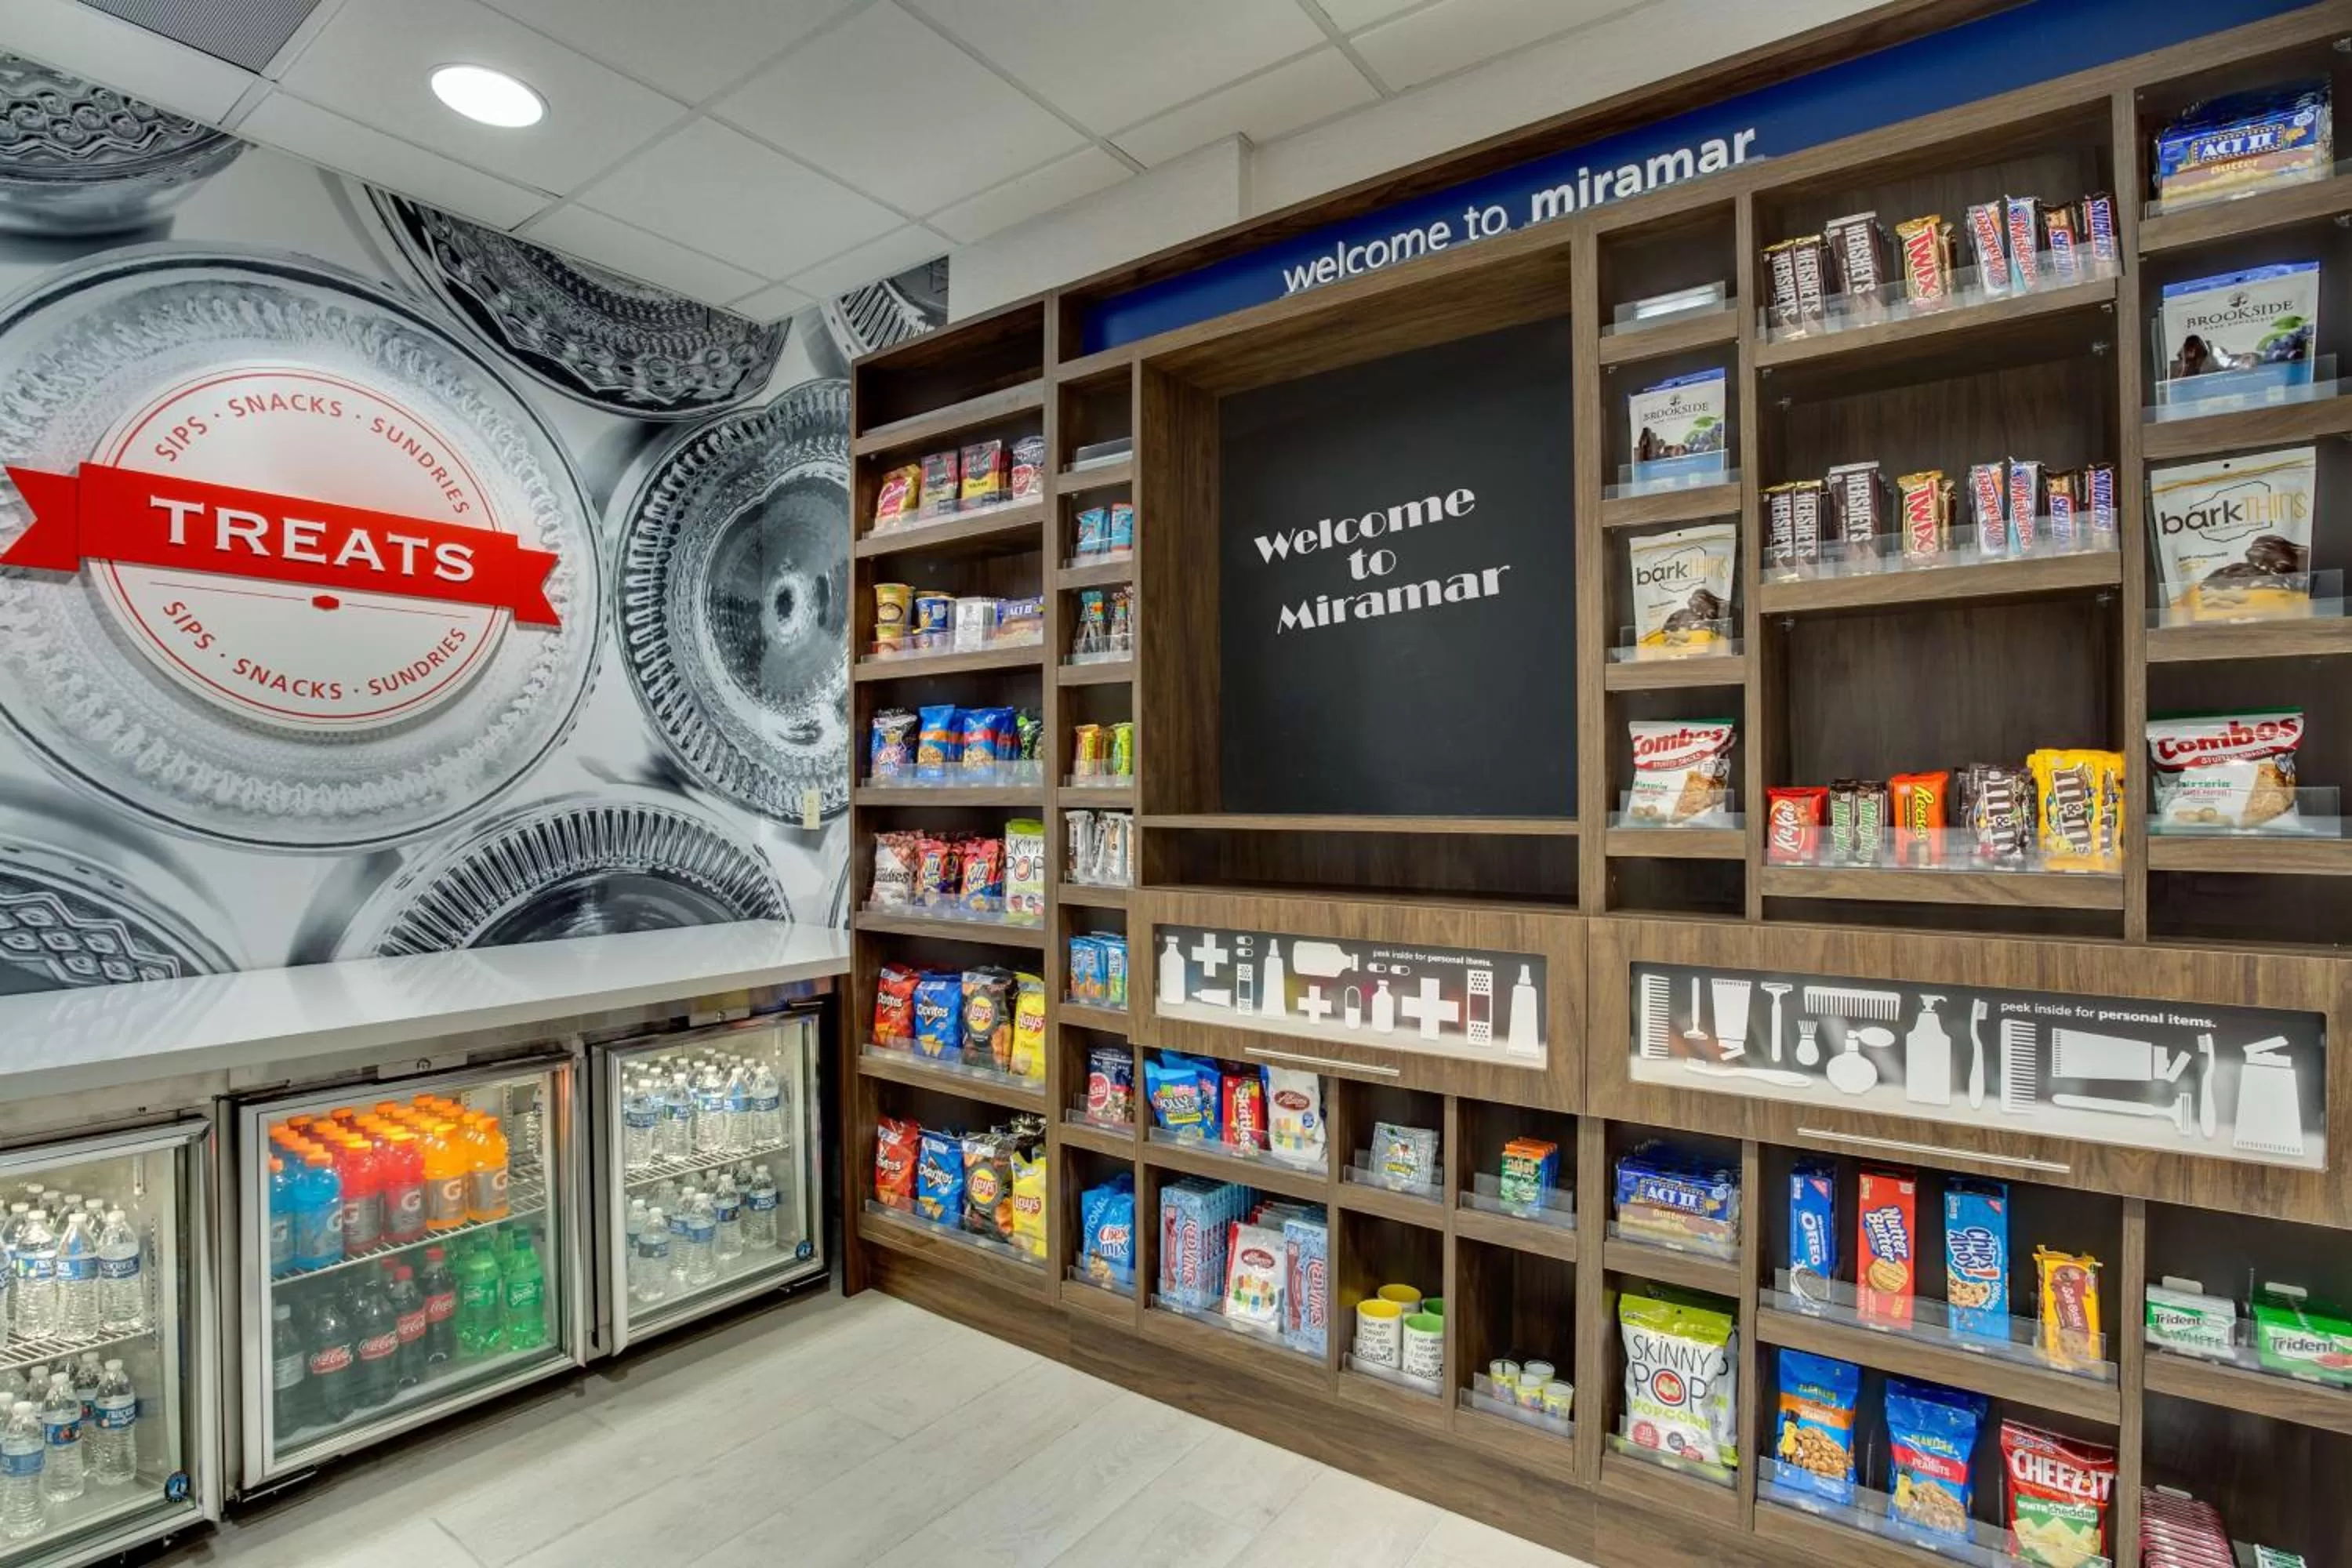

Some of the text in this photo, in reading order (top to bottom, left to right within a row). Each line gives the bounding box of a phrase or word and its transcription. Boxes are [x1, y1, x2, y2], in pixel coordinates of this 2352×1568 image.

[2201, 132, 2274, 158] ACT II
[1283, 127, 1757, 294] welcome to miramar
[2091, 200, 2113, 259] SNICKERS
[1845, 223, 1877, 296] HERSHEY'S
[1907, 225, 1938, 298] TWIX
[2186, 300, 2294, 329] BROOKSIDE
[1642, 401, 1709, 422] BROOKSIDE
[154, 393, 471, 516] SIPS SNACKS SUNDRIES
[1254, 488, 1476, 564] Welcome
[1846, 473, 1873, 543] HERSHEY'S
[1907, 481, 1936, 553] TWIX
[2093, 470, 2112, 531] SNICKERS
[149, 495, 477, 583] TREATS
[1347, 548, 1397, 581] to
[1276, 564, 1511, 636] Miramar
[162, 599, 466, 701] SIPS SNACKS SUNDRIES
[1633, 728, 1724, 759] Combos
[2158, 717, 2299, 760] Combos
[1008, 838, 1044, 855] SKINN
[1427, 955, 1464, 964] personal
[916, 1003, 949, 1018] Doritos
[2000, 1003, 2031, 1014] peek
[2034, 1003, 2072, 1017] inside
[2074, 1006, 2095, 1018] for
[2098, 1010, 2165, 1024] personal
[401, 1190, 422, 1212] G
[442, 1178, 462, 1201] G
[1647, 1186, 1678, 1202] ACT
[1801, 1210, 1821, 1266] OREO
[1865, 1211, 1896, 1264] Butter
[1881, 1206, 1909, 1259] Nutter
[2154, 1312, 2202, 1326] Trident
[2270, 1336, 2335, 1353] Trident
[1632, 1360, 1708, 1414] POP
